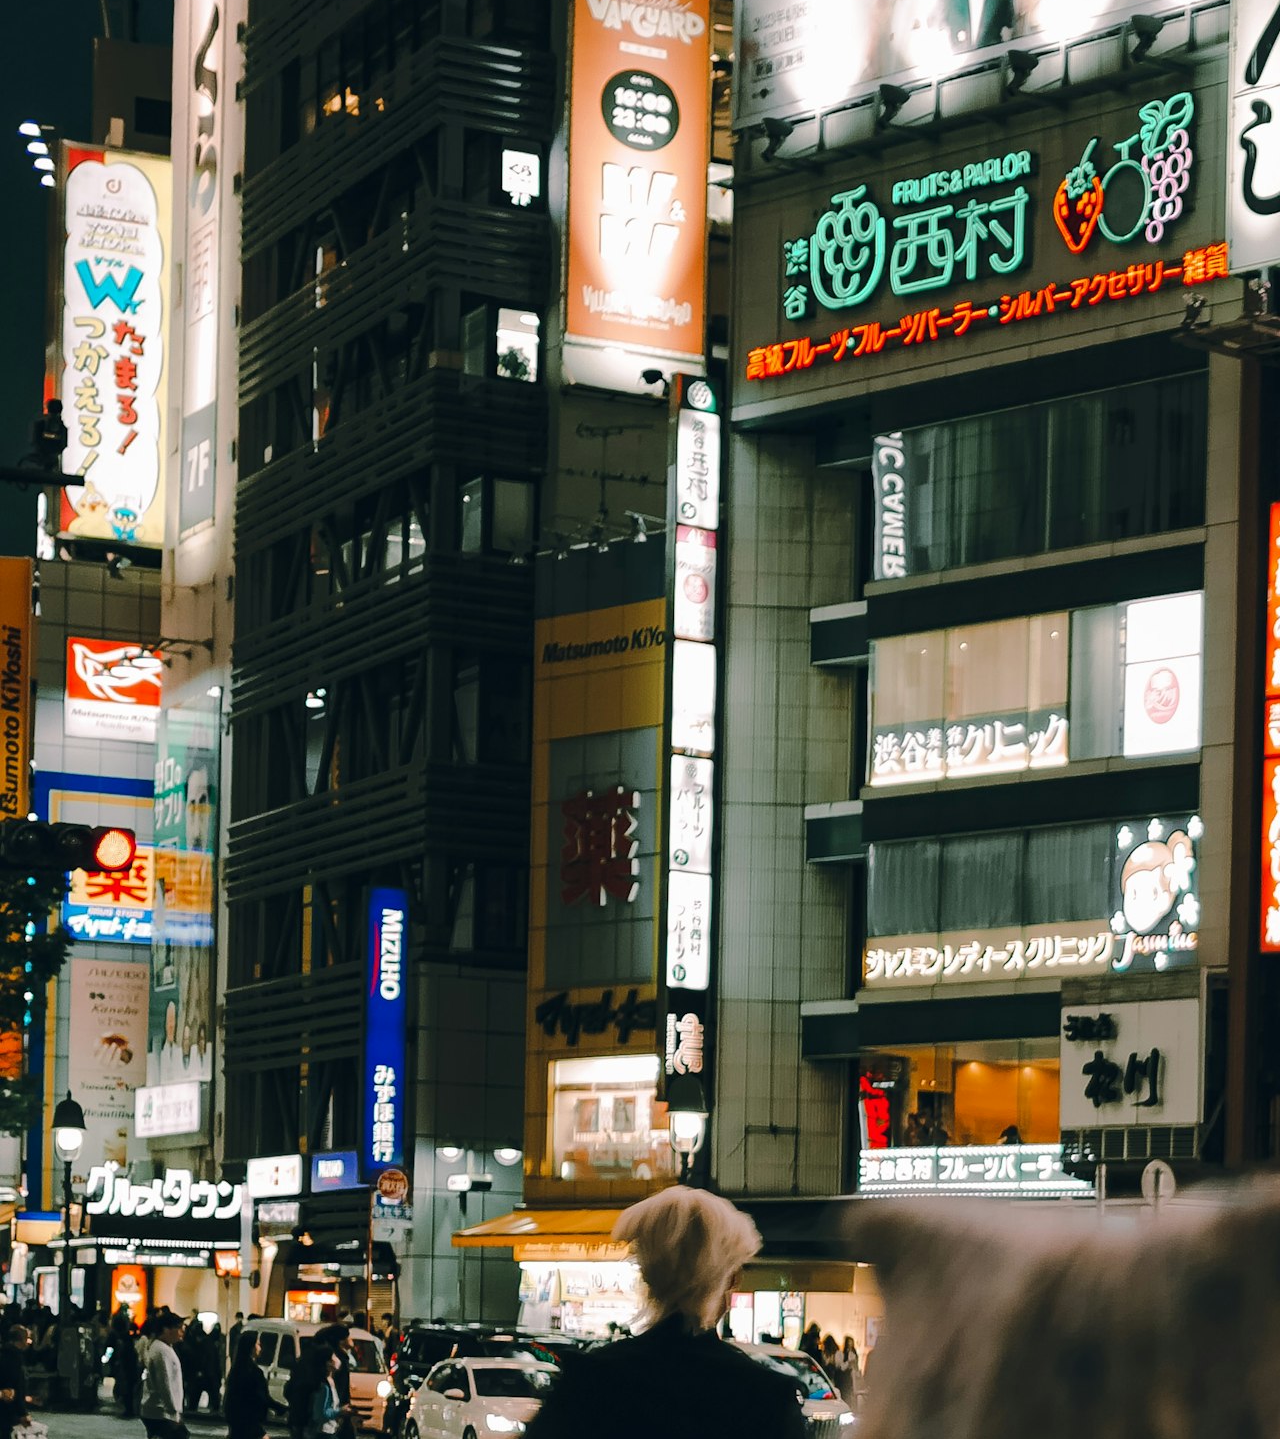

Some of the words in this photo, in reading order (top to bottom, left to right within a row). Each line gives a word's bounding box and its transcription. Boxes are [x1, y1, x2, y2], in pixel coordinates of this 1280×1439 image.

[783, 239, 809, 321] 渋谷
[889, 187, 1030, 296] 西村
[187, 438, 210, 493] 7F
[380, 907, 403, 1002] MIZUHO
[371, 1064, 396, 1164] みずほ銀行
[85, 1160, 243, 1220] グルメタウン
